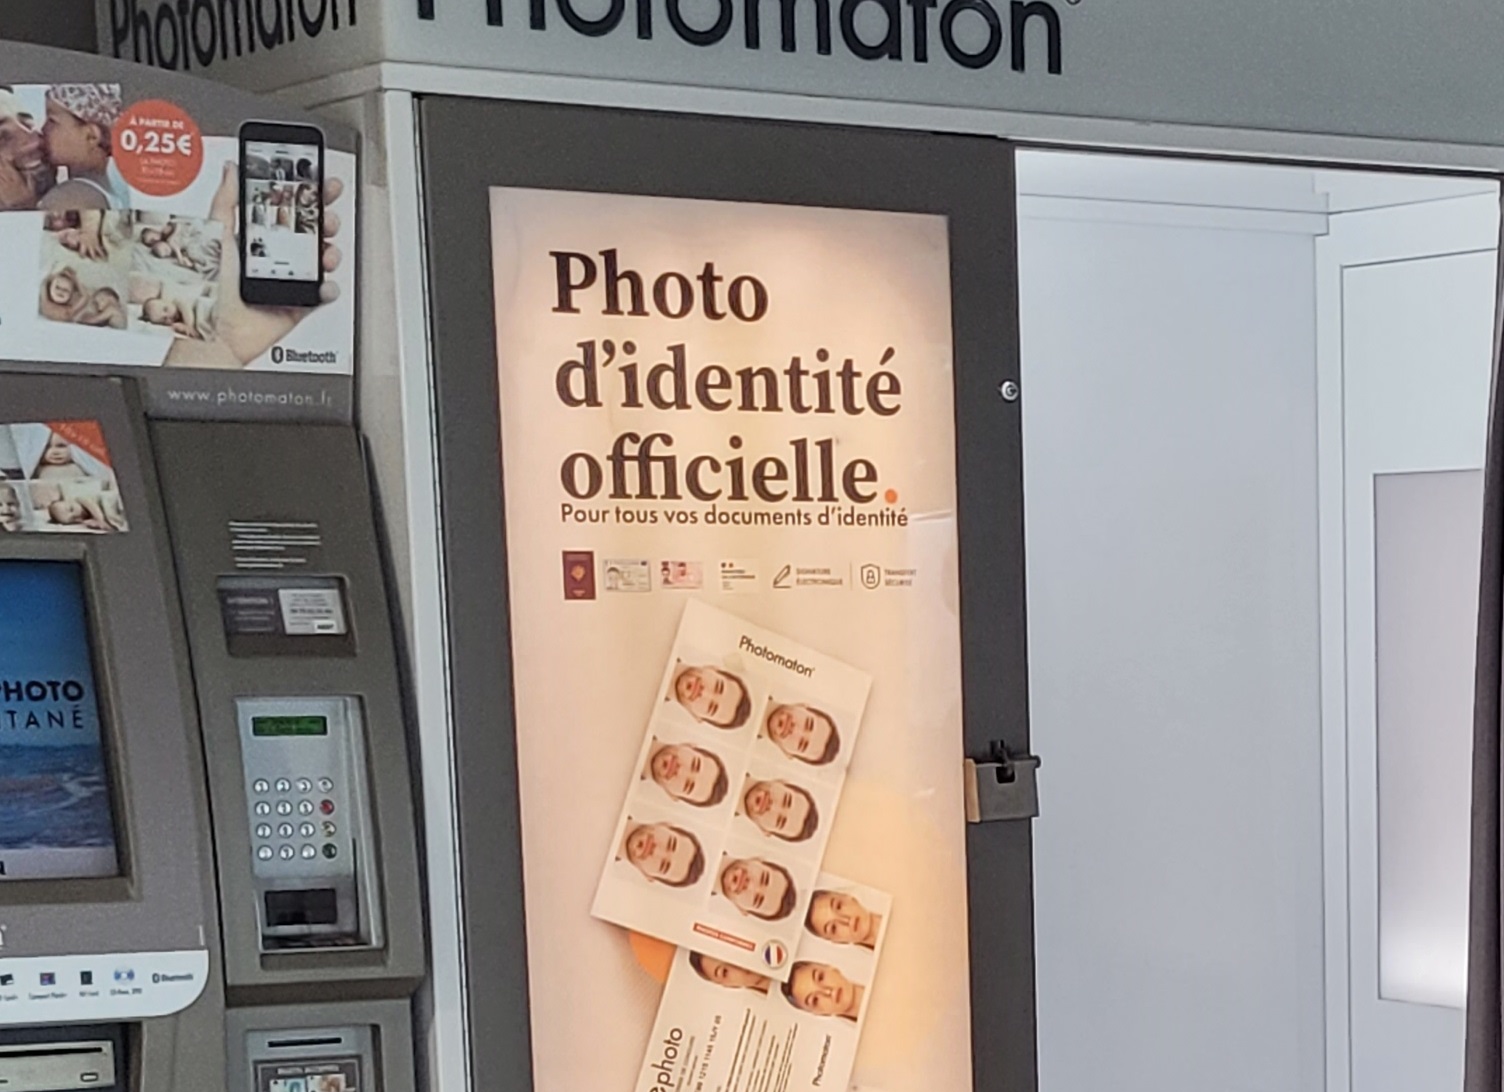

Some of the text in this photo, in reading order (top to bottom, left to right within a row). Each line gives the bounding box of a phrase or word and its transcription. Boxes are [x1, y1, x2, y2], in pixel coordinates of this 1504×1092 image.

[120, 129, 192, 156] 0,25€
[549, 248, 769, 322] Photo
[285, 349, 337, 364] Bluetooth
[556, 339, 902, 416] d’identité
[560, 432, 898, 504] officielle.
[561, 503, 908, 527] Pour tous vos documents d’identité
[738, 635, 816, 678] Photomaton
[0, 680, 84, 702] HOTO
[0, 704, 84, 729] TANÉ
[812, 1034, 832, 1087] Photomaton
